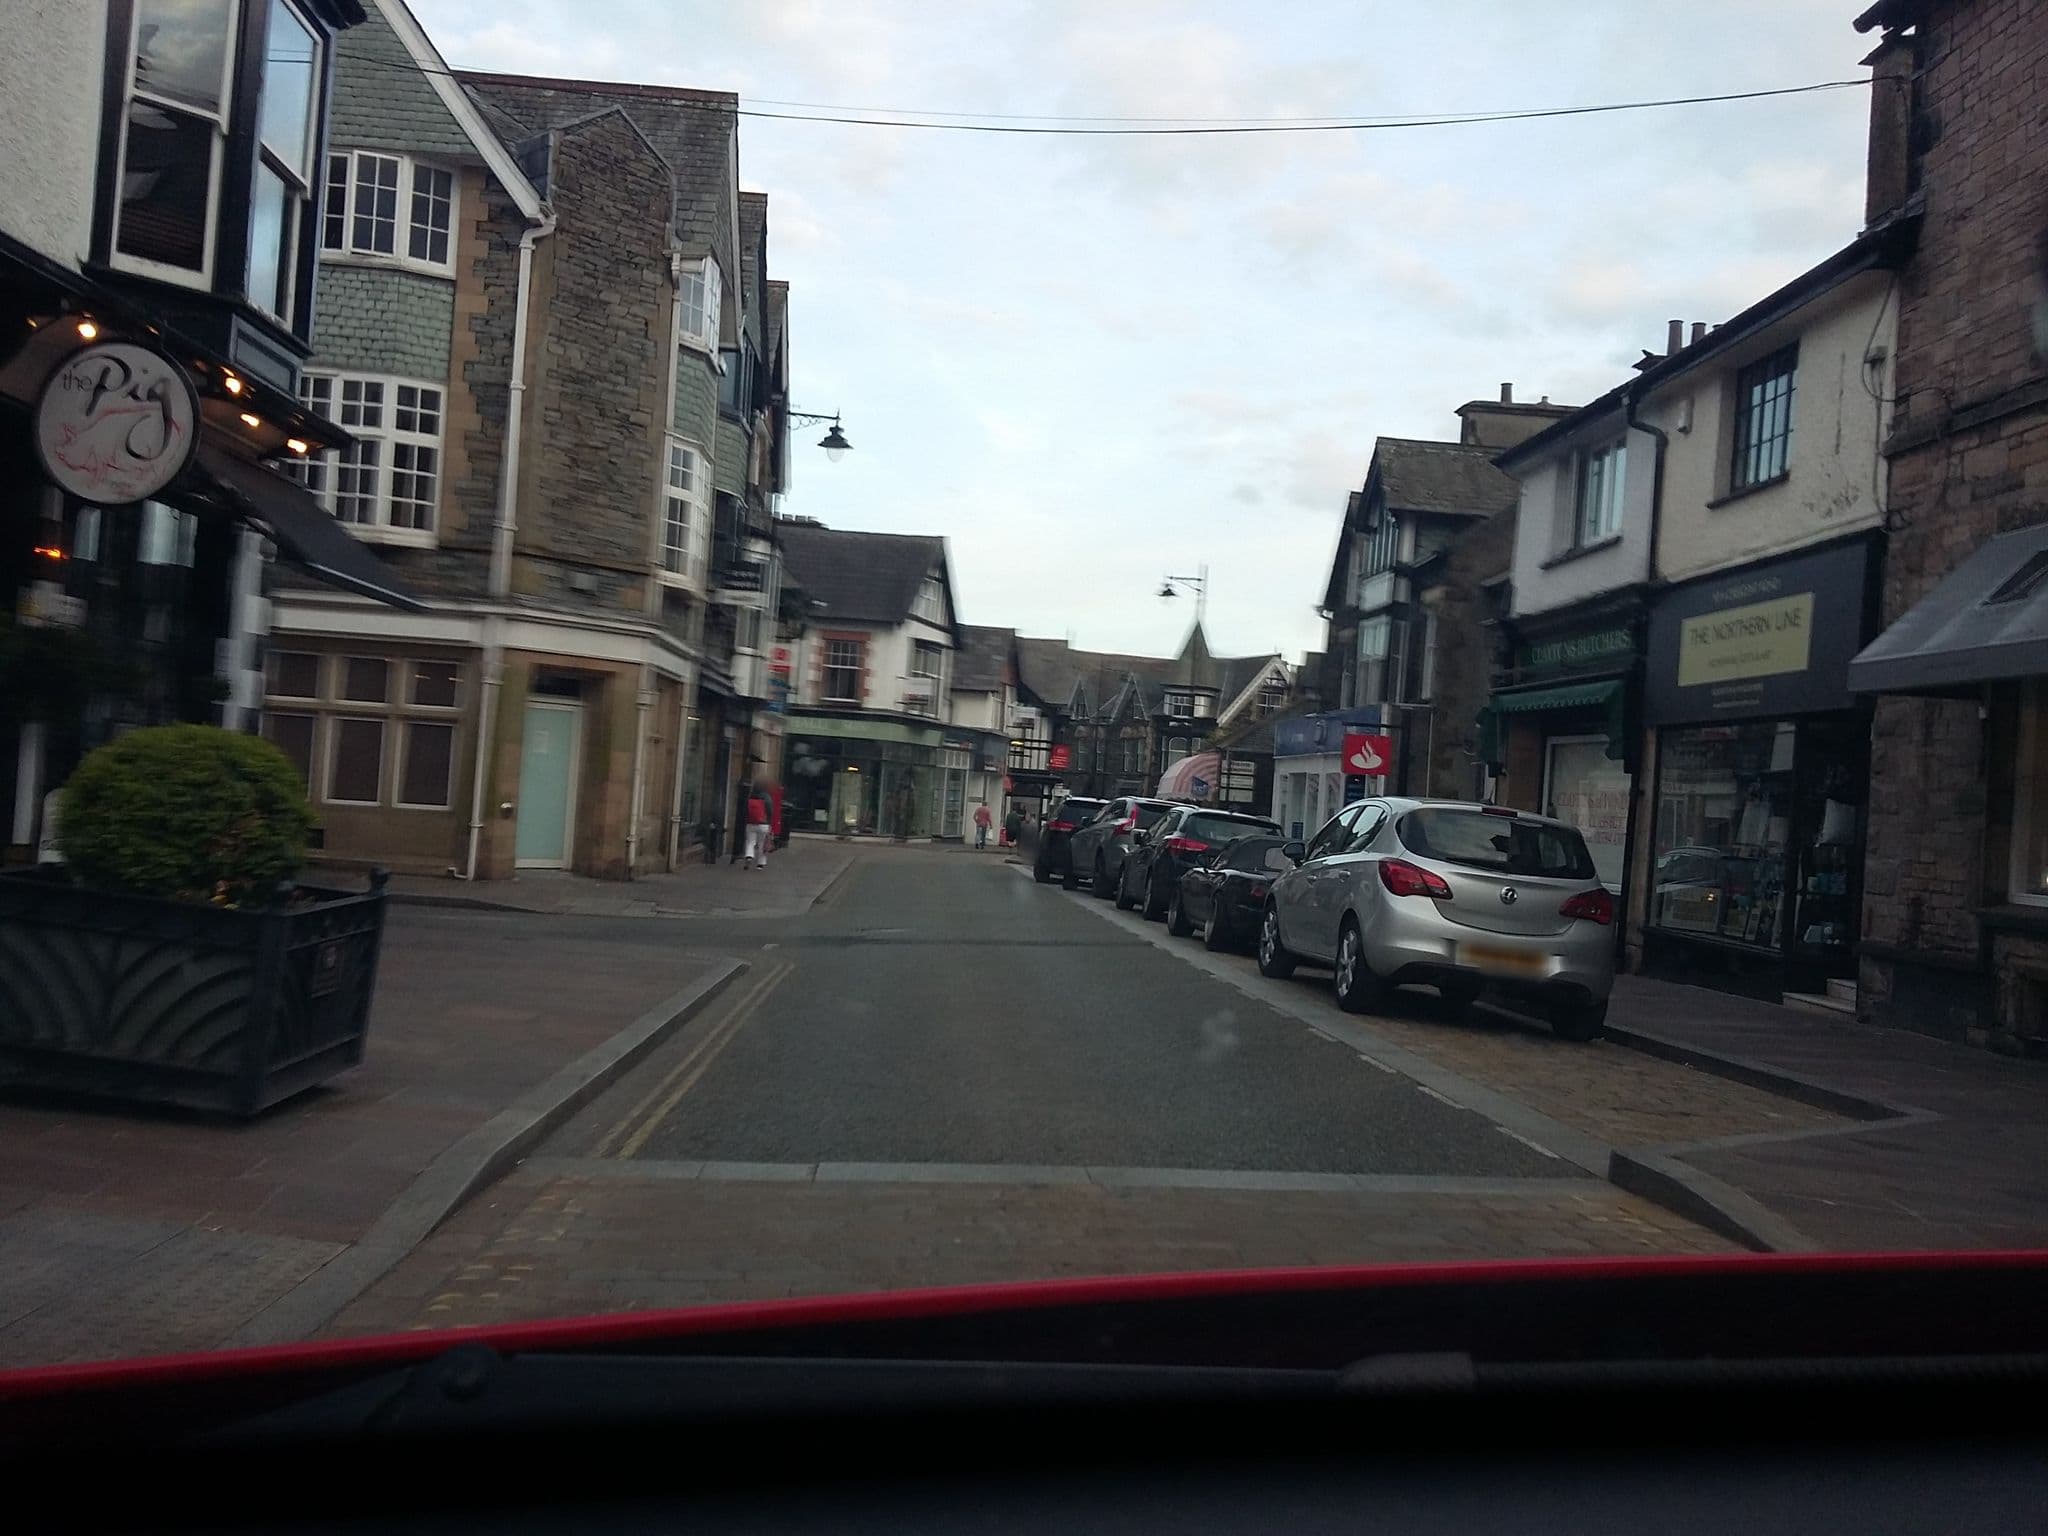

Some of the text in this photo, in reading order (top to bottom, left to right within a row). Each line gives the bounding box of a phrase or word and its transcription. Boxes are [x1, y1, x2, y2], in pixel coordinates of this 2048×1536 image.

[62, 355, 173, 461] the Pig
[1577, 628, 1632, 656] BUTCHERS
[1689, 607, 1802, 647] THE NORTHERN LINE
